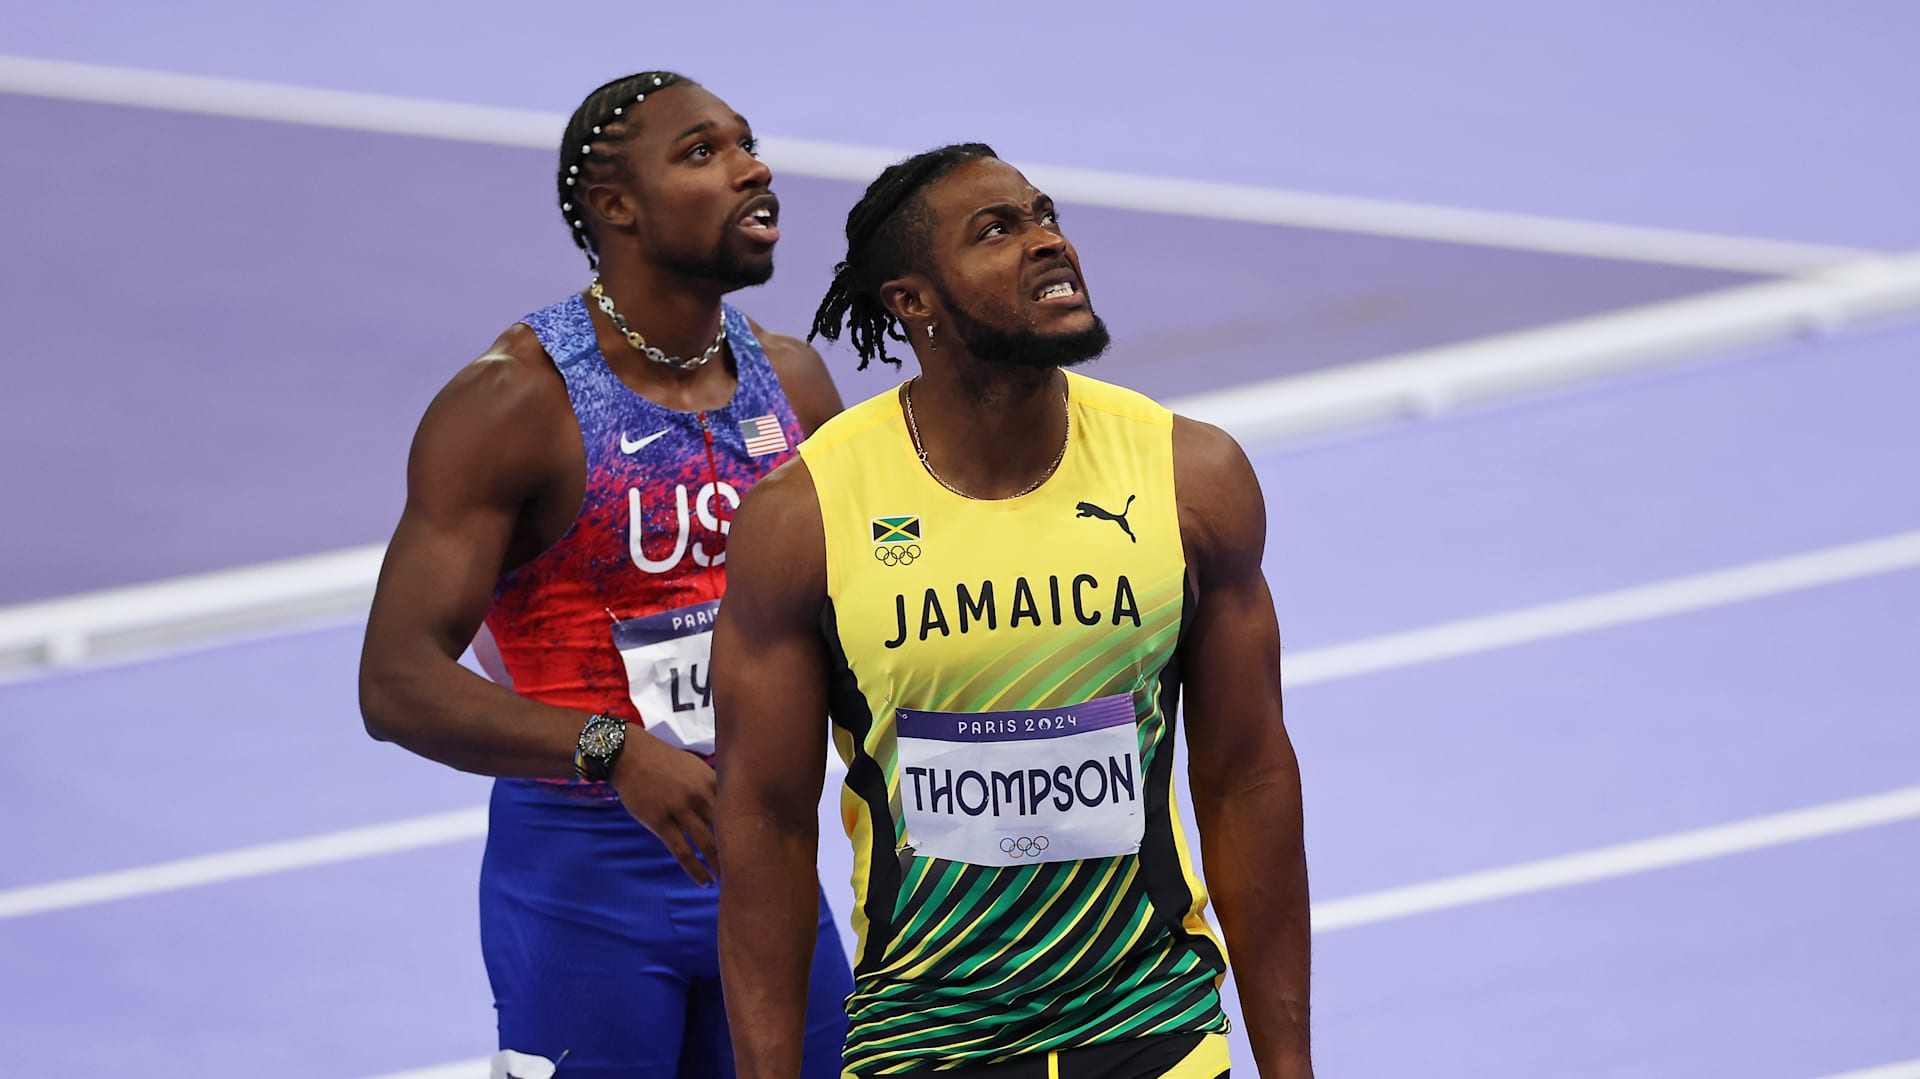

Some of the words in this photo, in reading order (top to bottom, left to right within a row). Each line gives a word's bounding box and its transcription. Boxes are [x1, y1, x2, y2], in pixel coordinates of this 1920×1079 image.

[884, 573, 1142, 649] JAMAICA
[669, 664, 712, 713] LY
[957, 718, 1017, 735] PARIS
[1025, 714, 1078, 733] 2024
[905, 753, 1136, 817] THOMPSON
